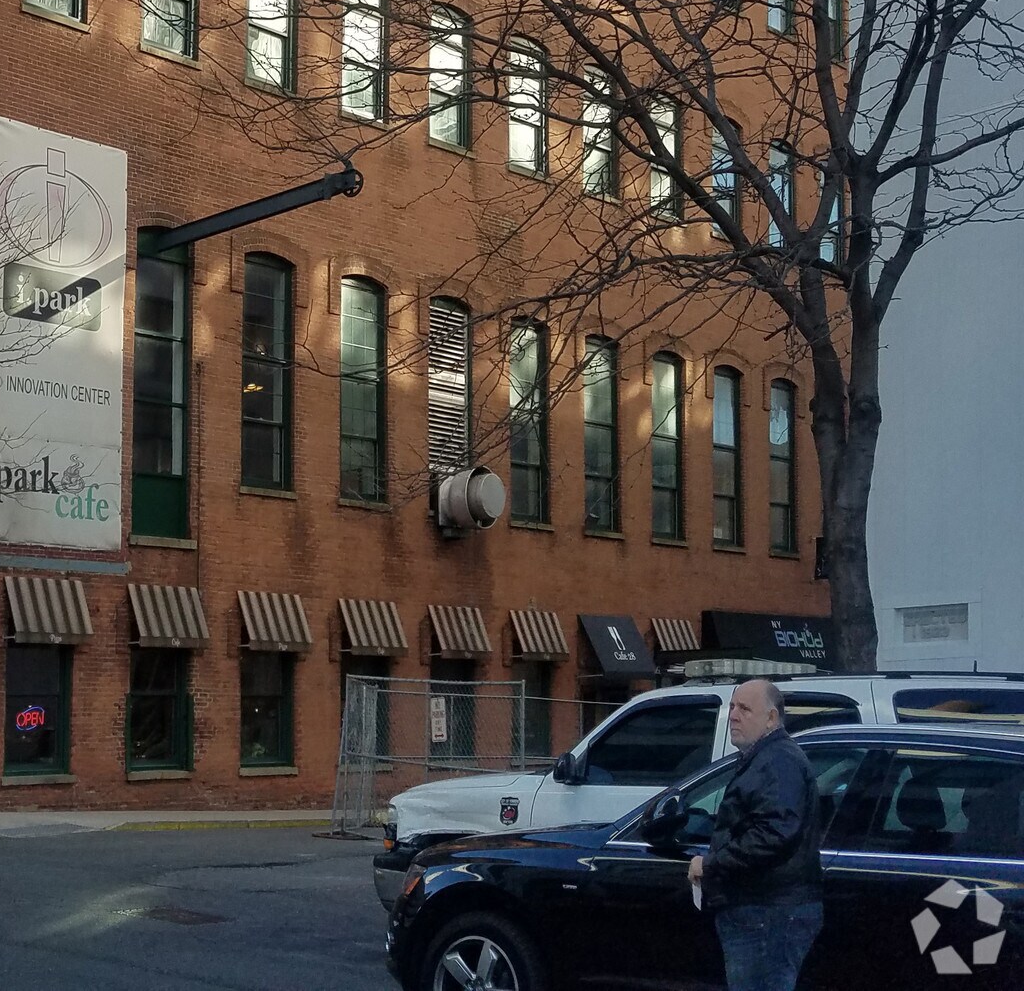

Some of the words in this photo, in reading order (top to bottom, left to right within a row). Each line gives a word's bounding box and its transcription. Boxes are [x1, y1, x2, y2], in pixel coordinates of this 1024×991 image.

[6, 375, 68, 399] INNOVATION
[70, 385, 111, 406] CENTER
[55, 483, 109, 522] cafe
[771, 620, 782, 629] NY
[628, 652, 636, 660] 28
[800, 650, 826, 659] VALLEY
[17, 711, 45, 726] OPEN
